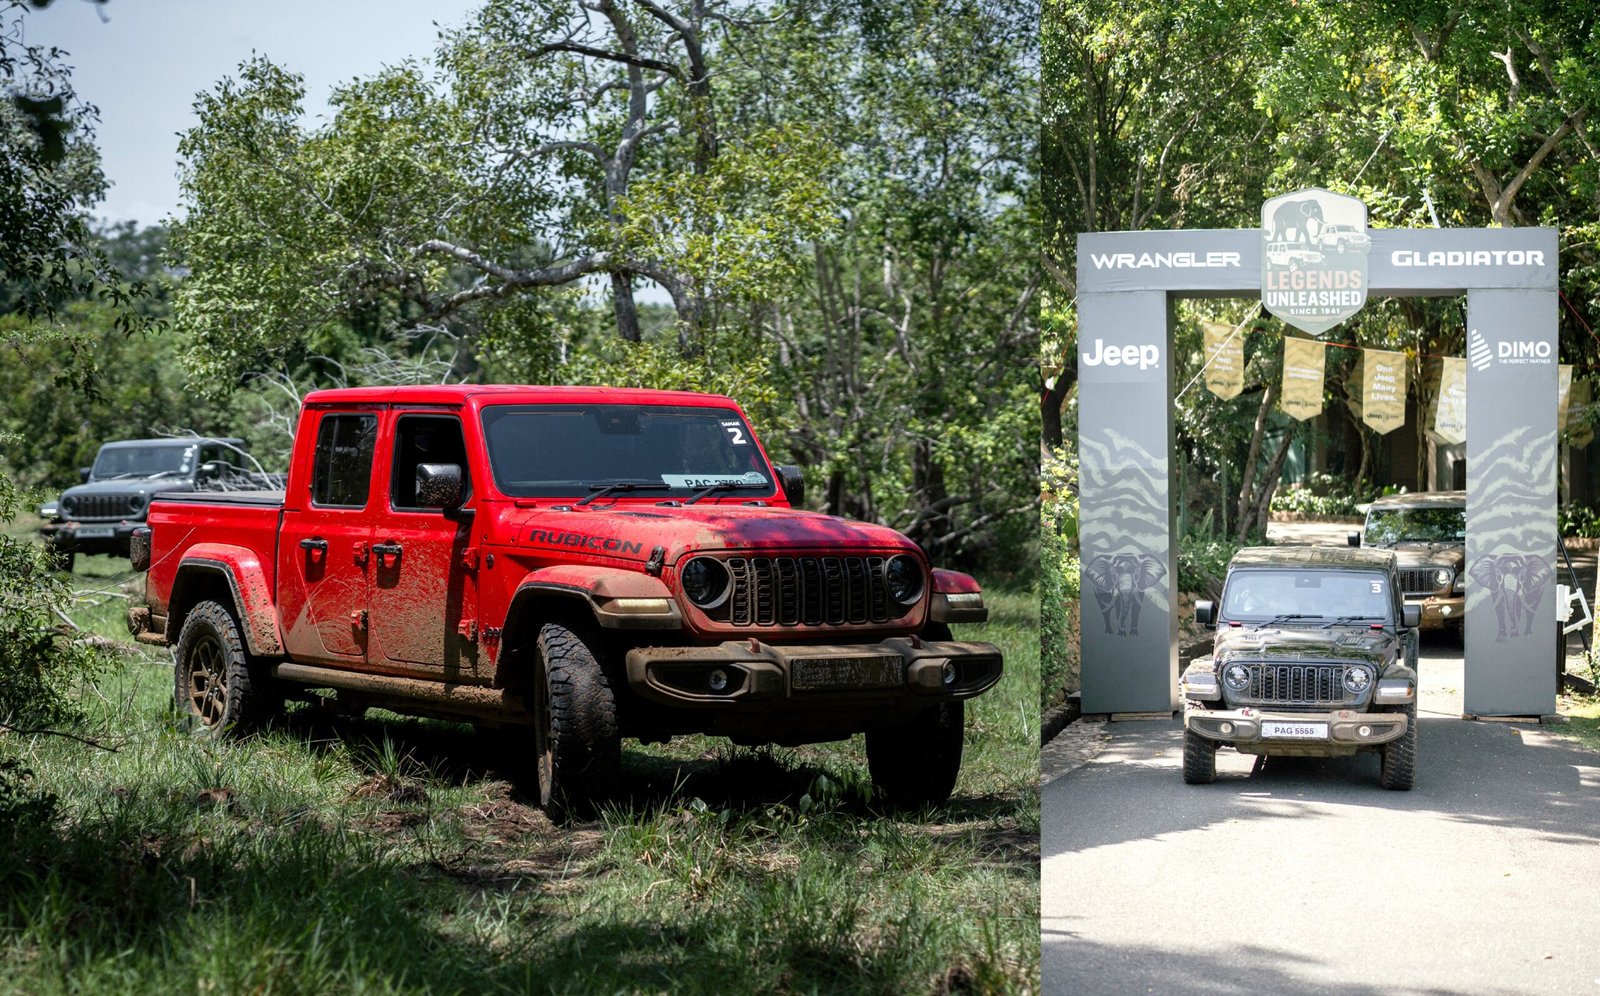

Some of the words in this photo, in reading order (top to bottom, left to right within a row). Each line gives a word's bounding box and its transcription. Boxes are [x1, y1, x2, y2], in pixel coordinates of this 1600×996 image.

[1090, 252, 1241, 269] WRANGLER
[1391, 250, 1545, 267] GLADIATOR
[1266, 270, 1362, 290] LEGENDS
[1266, 290, 1361, 307] UNLEASHED
[1082, 338, 1160, 370] Jeep
[1498, 341, 1551, 358] DIMO
[1376, 364, 1393, 373] One
[1375, 373, 1395, 383] Jeep
[1373, 383, 1396, 393] Many
[1371, 393, 1397, 401] Lives.
[727, 427, 747, 445] 2
[529, 529, 643, 554] RUBICON
[1371, 583, 1382, 593] 3
[1295, 727, 1315, 735] 5555
